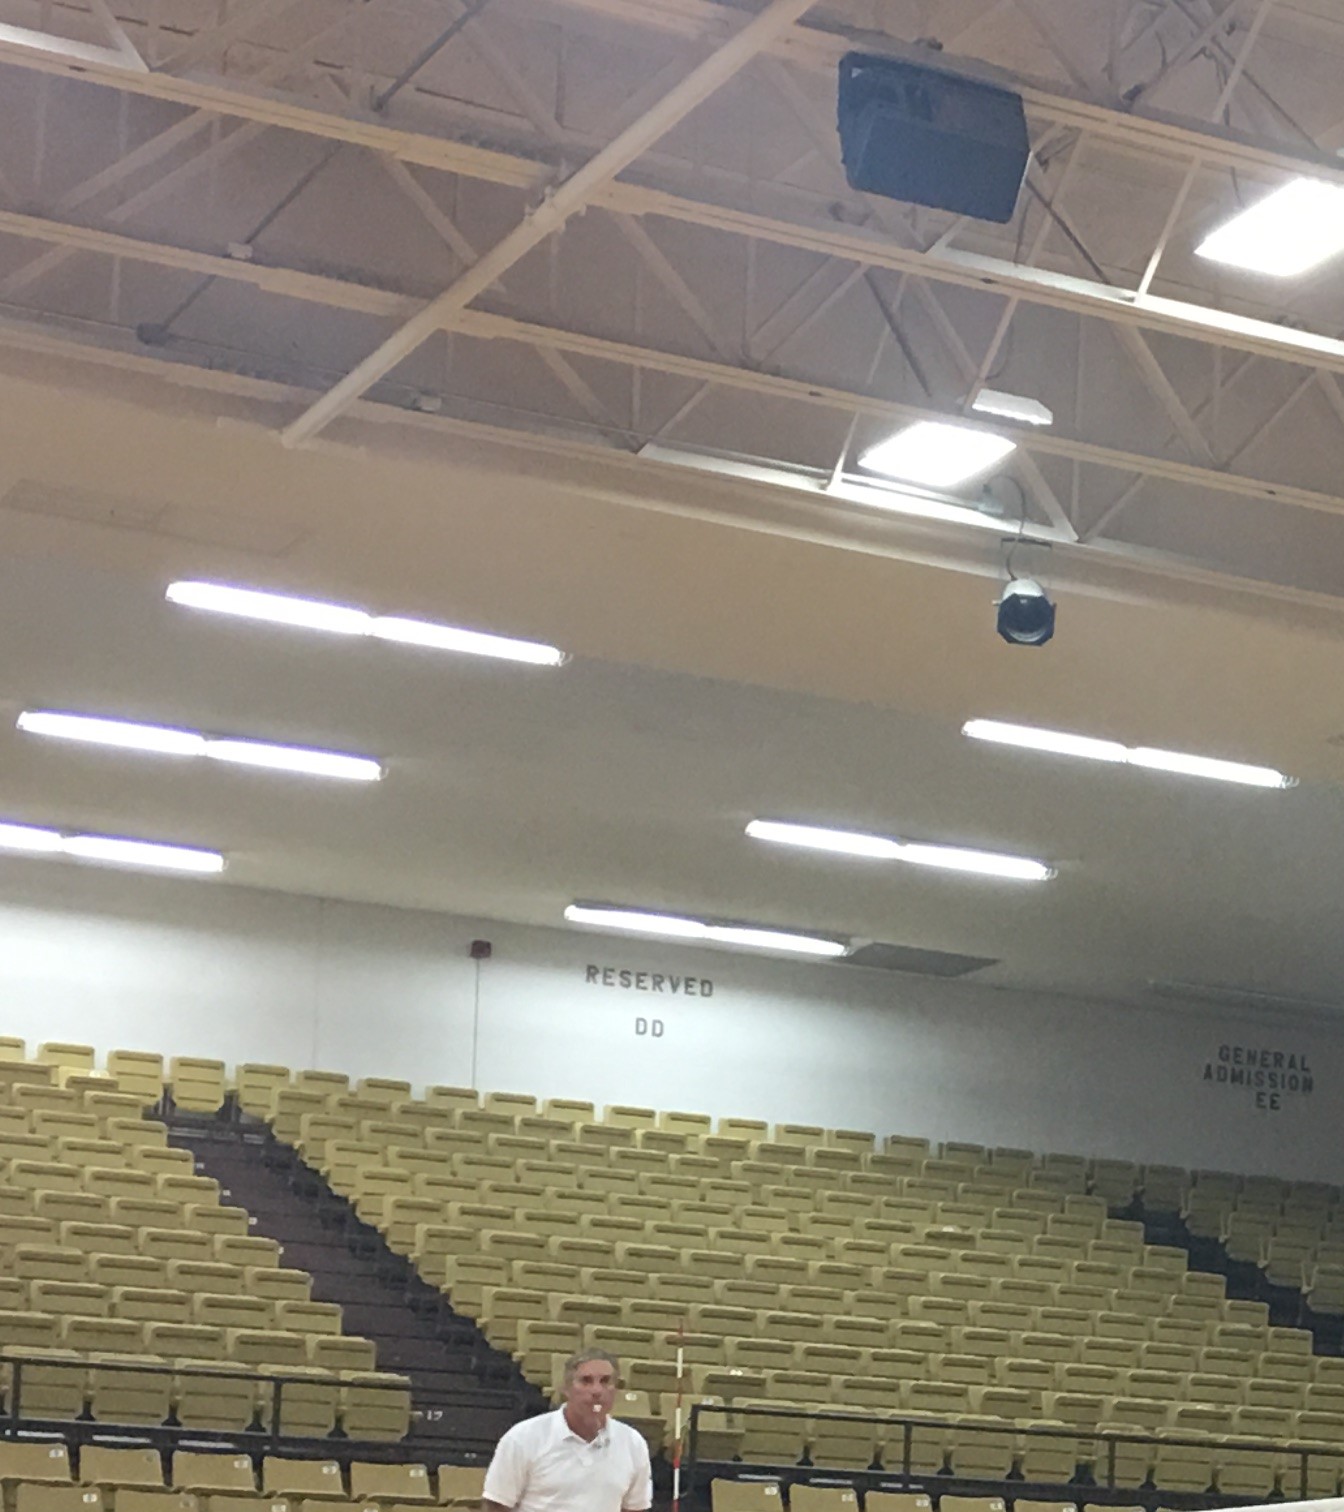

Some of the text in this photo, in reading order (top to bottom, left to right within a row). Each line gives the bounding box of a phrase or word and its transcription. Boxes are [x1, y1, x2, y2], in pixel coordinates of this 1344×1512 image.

[585, 964, 713, 997] RESERVED
[635, 1017, 664, 1037] DD
[1218, 1044, 1310, 1073] GENERAL
[1203, 1063, 1314, 1093] ADMISSION
[1256, 1091, 1281, 1111] EE
